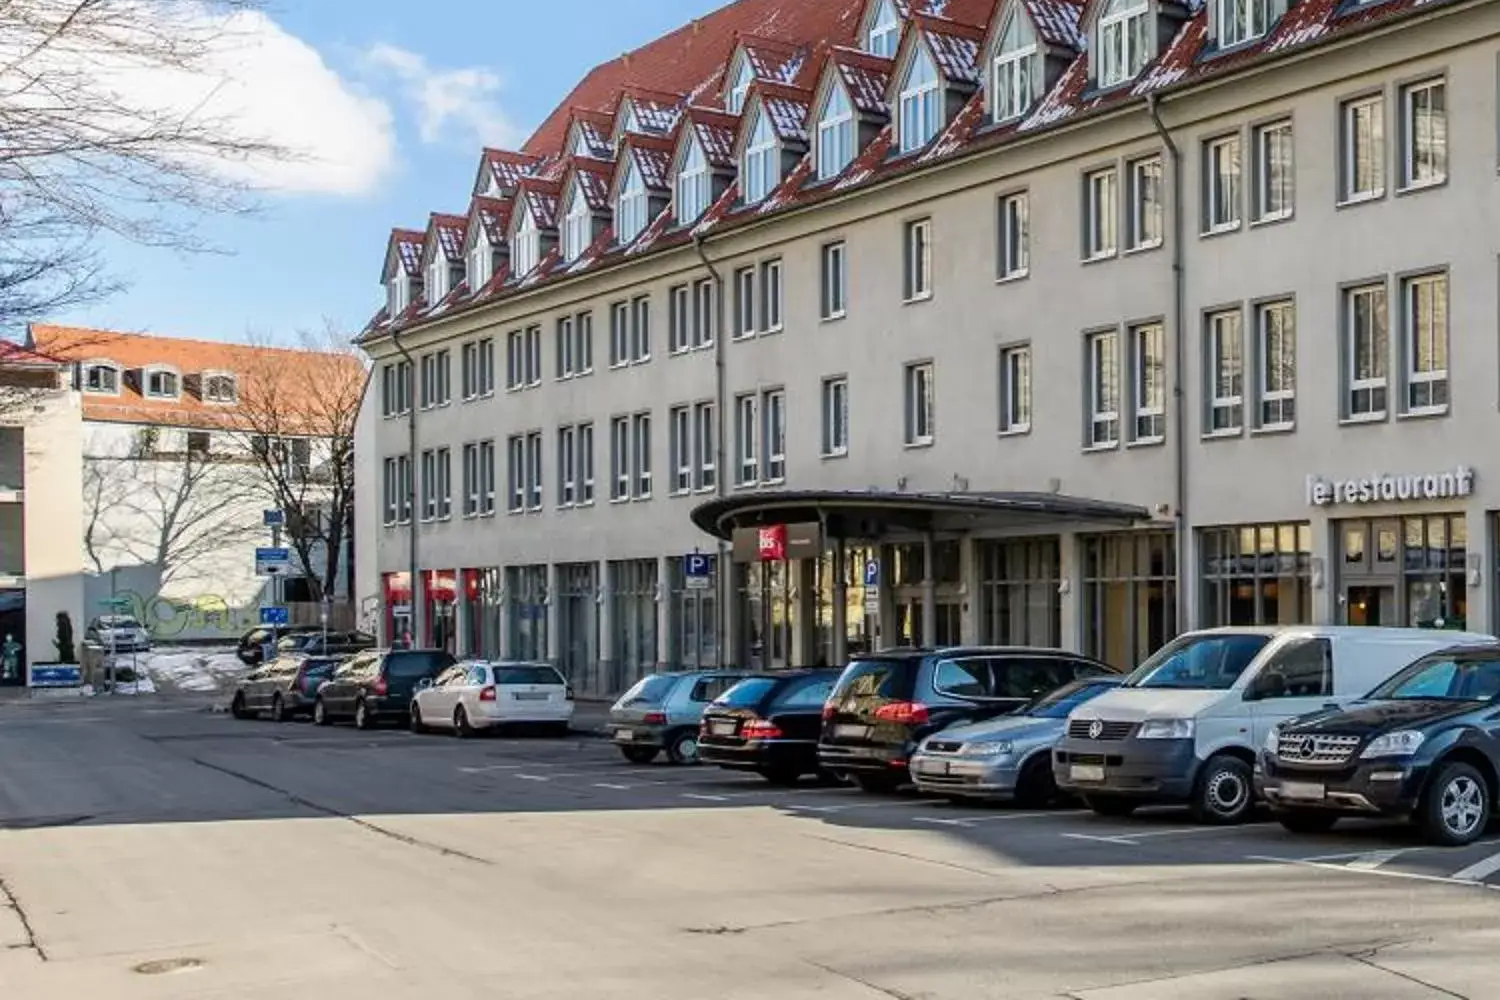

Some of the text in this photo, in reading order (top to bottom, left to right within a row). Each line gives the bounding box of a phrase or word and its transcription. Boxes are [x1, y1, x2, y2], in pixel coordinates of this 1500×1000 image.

[1306, 465, 1473, 505] le restaurant
[691, 556, 705, 573] P
[867, 562, 877, 582] P
